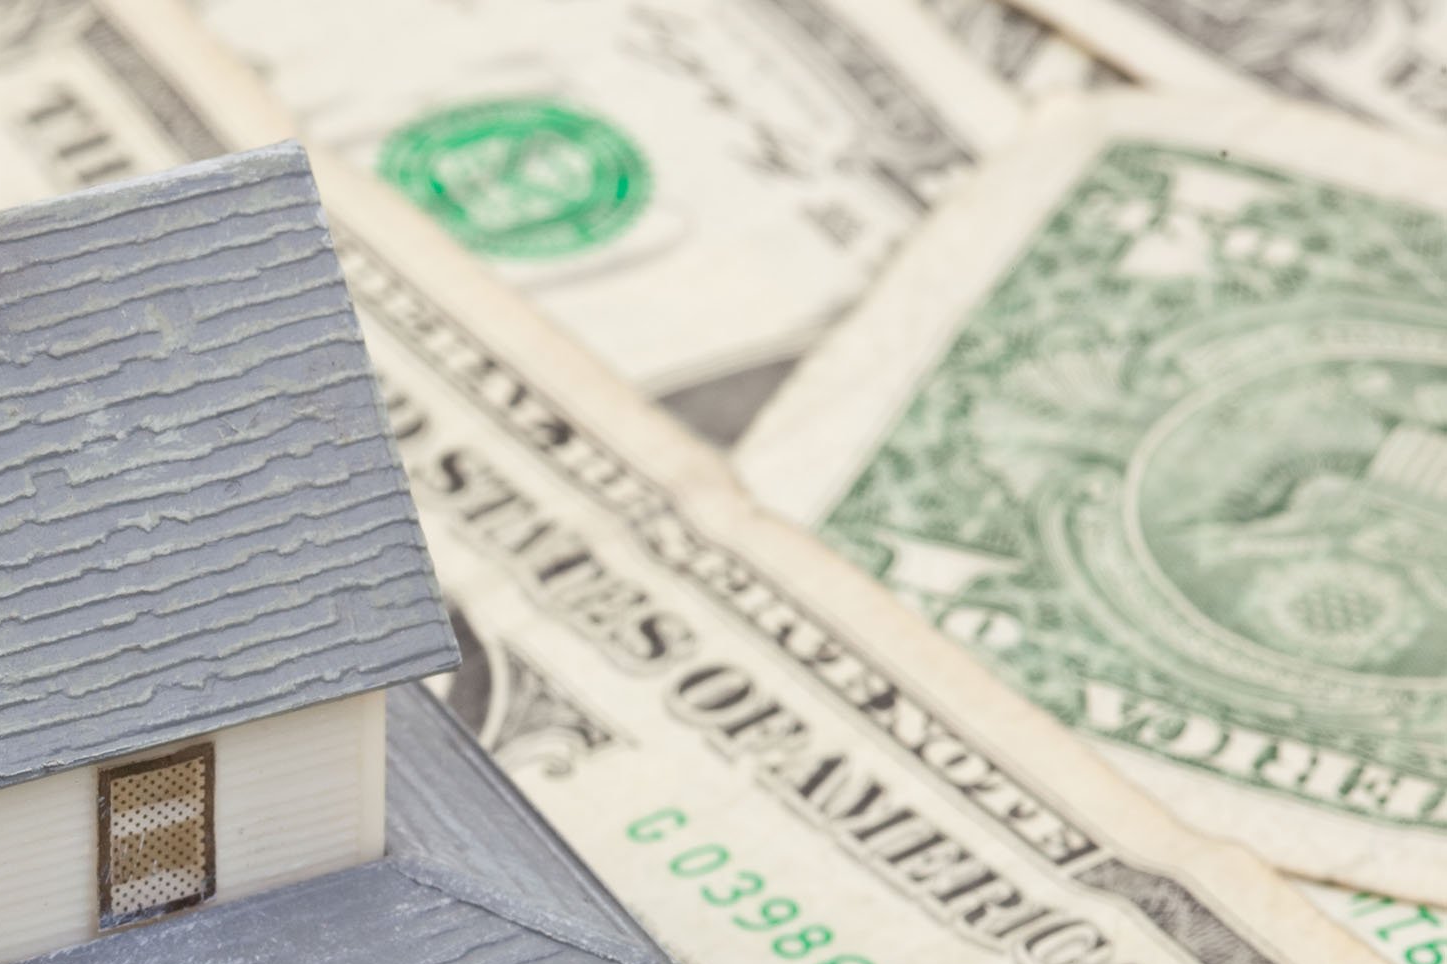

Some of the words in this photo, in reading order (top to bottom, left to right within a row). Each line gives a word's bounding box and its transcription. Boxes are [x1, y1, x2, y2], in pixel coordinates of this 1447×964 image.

[439, 450, 695, 662] STATES
[668, 662, 809, 757] OF
[873, 692, 1085, 862] NOTE
[1082, 680, 1447, 825] ERICA
